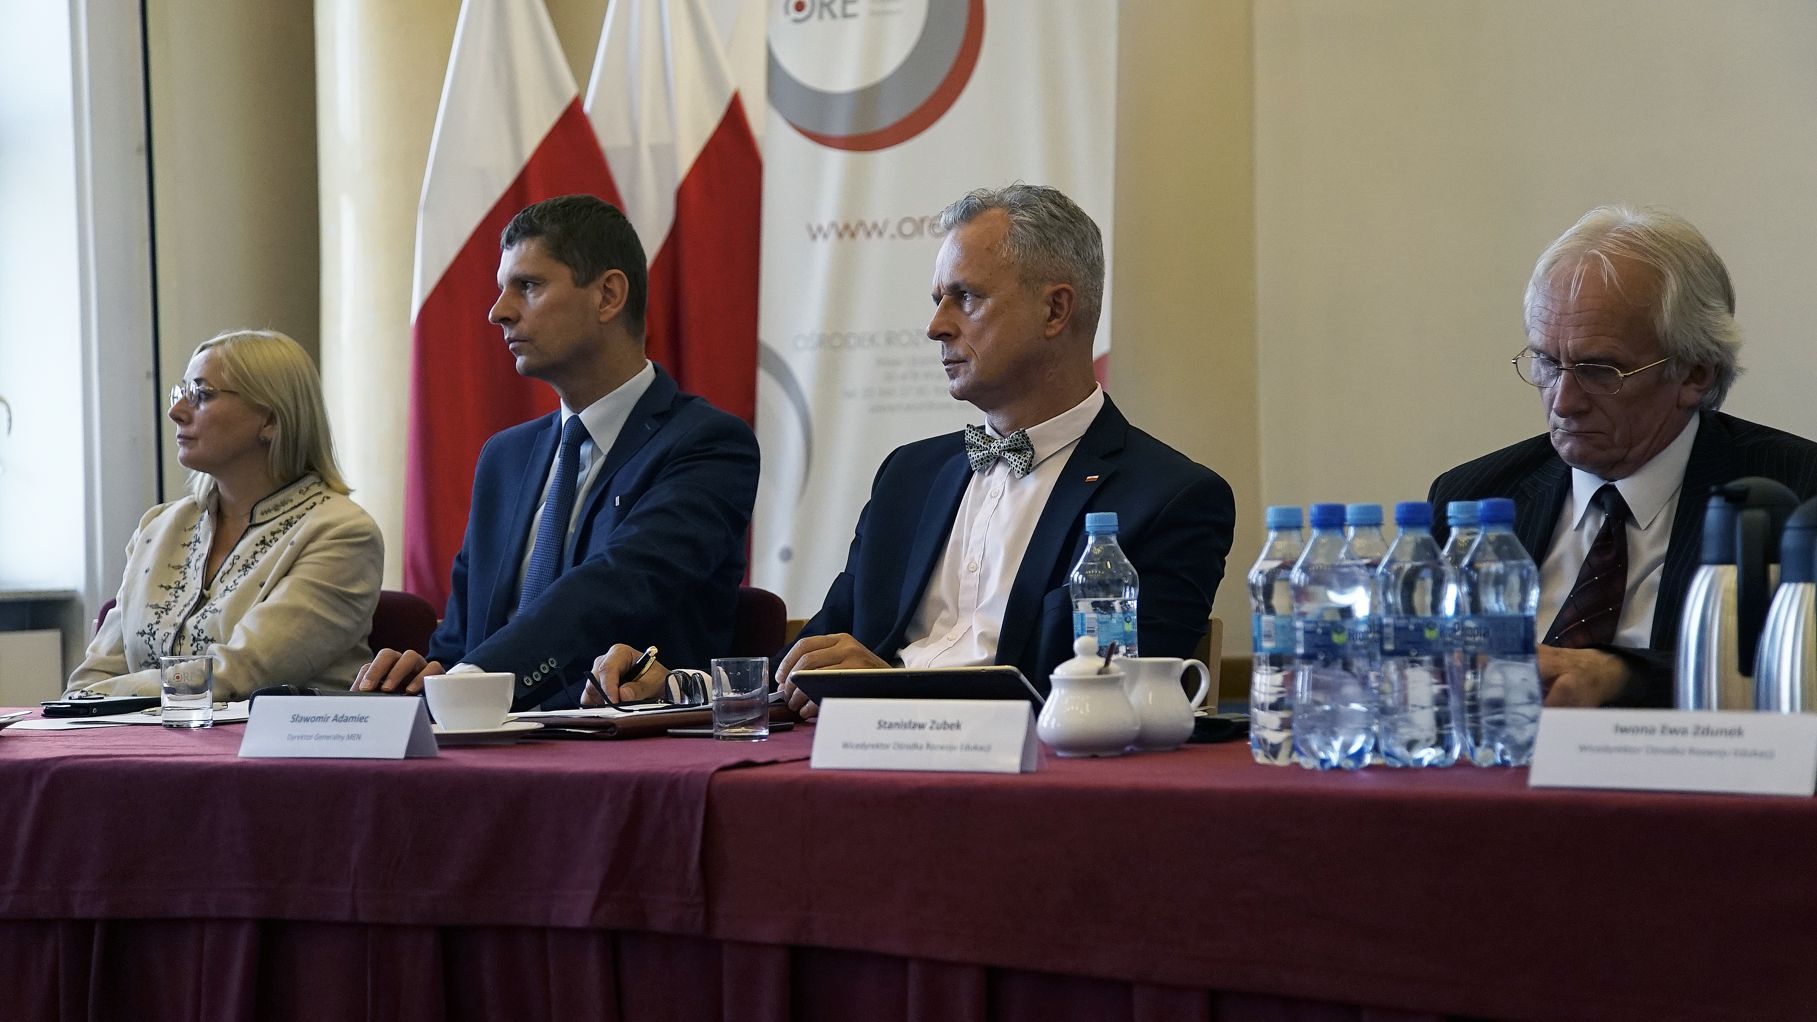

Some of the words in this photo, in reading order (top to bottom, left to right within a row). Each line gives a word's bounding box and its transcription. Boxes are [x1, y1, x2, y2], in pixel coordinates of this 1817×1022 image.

[290, 713, 330, 723] Sławomir
[331, 713, 369, 723] Adamiec
[876, 719, 927, 731] Stanisław
[929, 719, 962, 731] Zubek
[1614, 723, 1656, 736] Iwona
[1660, 724, 1688, 736] Ewa
[1692, 724, 1745, 738] Zdunek
